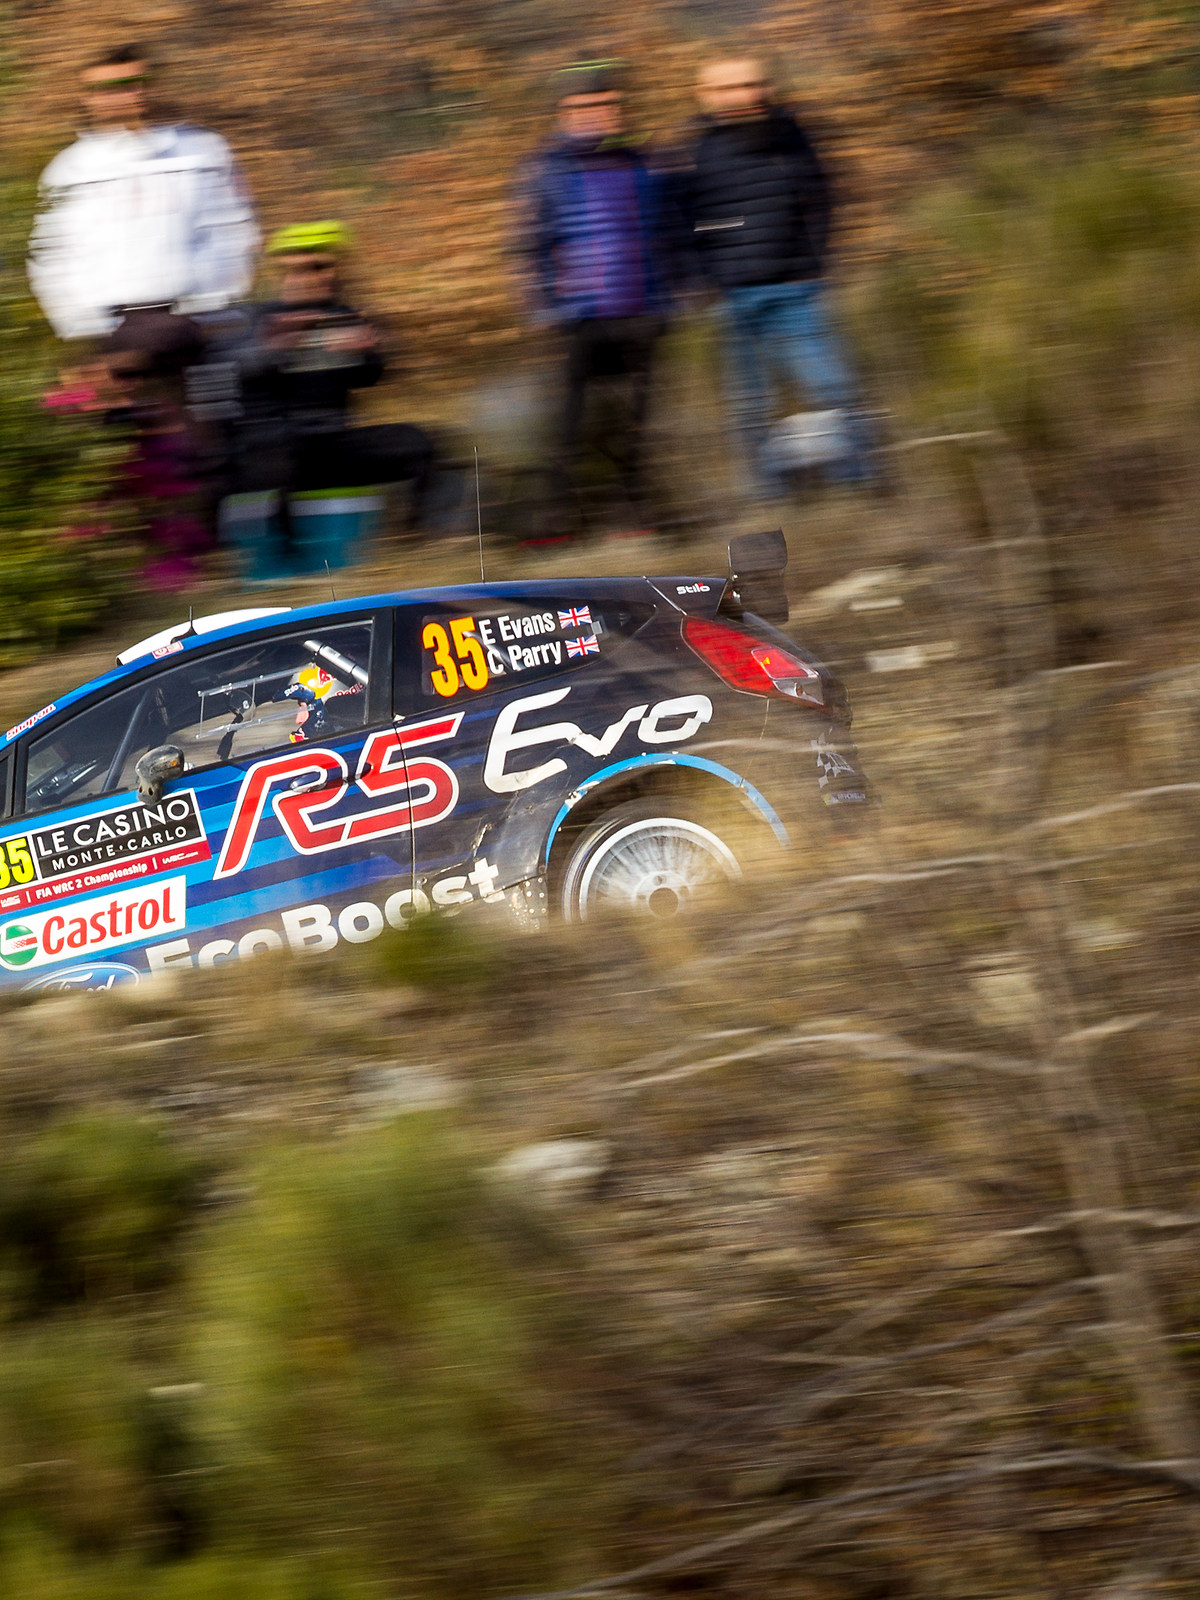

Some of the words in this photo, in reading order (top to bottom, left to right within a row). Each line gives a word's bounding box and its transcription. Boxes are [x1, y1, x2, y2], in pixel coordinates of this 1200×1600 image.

[422, 616, 489, 698] 35
[478, 619, 496, 646] E
[497, 612, 557, 642] Evans
[486, 649, 505, 675] C
[507, 640, 563, 672] Parry
[213, 711, 465, 881] R5
[36, 831, 69, 857] LE
[73, 799, 190, 847] CASINO
[35, 886, 53, 900] FIA
[52, 880, 75, 896] WRC
[75, 878, 83, 890] 2
[84, 861, 148, 887] Championship
[42, 886, 176, 955] Castrol
